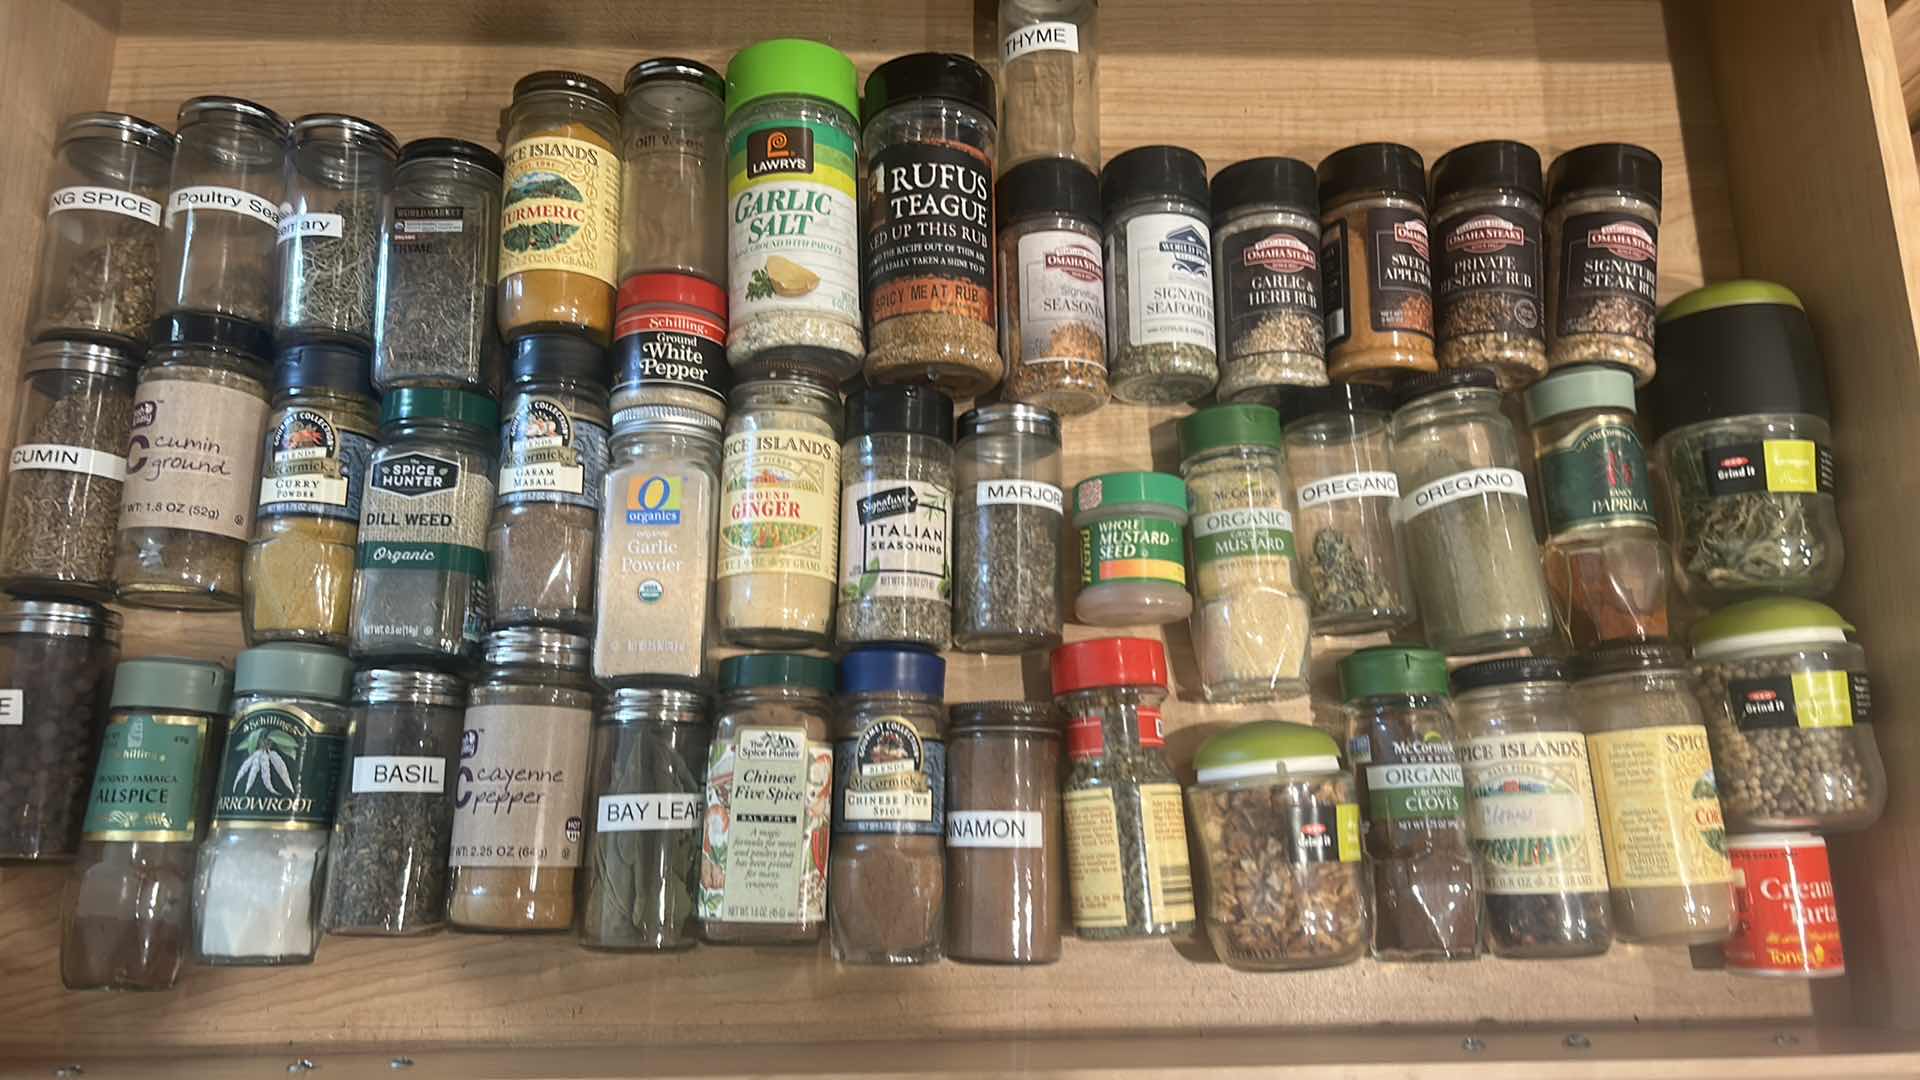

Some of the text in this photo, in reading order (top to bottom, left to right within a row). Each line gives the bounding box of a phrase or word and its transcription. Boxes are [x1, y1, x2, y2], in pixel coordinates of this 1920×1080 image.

[1005, 28, 1066, 57] THYME
[529, 143, 599, 167] ISLANDS
[891, 162, 988, 201] RUFUS
[82, 191, 153, 217] SPICE
[177, 191, 242, 214] Poultry
[735, 188, 833, 224] GARLIC
[503, 205, 586, 227] TURMERIC
[890, 194, 988, 229] TEAGUE
[748, 214, 814, 245] SALT
[891, 221, 988, 249] UP THIS RUB
[1449, 229, 1521, 245] OMAHA STEAKS
[1591, 234, 1631, 246] OMAHA
[924, 242, 943, 252] OUT
[944, 243, 955, 253] OF
[957, 245, 974, 259] THIN
[1247, 248, 1314, 261] OMAHA STEAKS
[912, 256, 939, 266] TAKEN
[969, 260, 979, 271] TO
[1047, 254, 1084, 268] OMAHA
[1391, 254, 1425, 273] SWEET
[1455, 256, 1516, 276] PRIVATE
[1251, 274, 1306, 290] GARLIC
[1506, 271, 1532, 289] RUB
[1583, 274, 1635, 291] STEAK
[910, 283, 950, 301] MEAT
[955, 283, 979, 303] RUB
[1249, 289, 1317, 309] HERB RUB
[649, 315, 705, 335] Schilling
[657, 332, 698, 347] Ground
[642, 342, 703, 364] White
[639, 359, 709, 384] Pepper
[535, 401, 568, 440] COLLECTION
[299, 411, 334, 451] COLLECTION
[154, 436, 221, 454] cumin
[756, 437, 833, 461] ISLANDS
[12, 449, 79, 465] CUMIN
[144, 456, 231, 481] ground
[390, 464, 435, 476] SPICE
[515, 467, 555, 477] GARAM
[1717, 465, 1746, 480] Grind
[275, 479, 321, 489] CURRY
[382, 475, 443, 488] HUNTER
[513, 479, 556, 488] MASALA
[1302, 477, 1397, 501] OREGANO
[1415, 472, 1515, 508] OREGANO
[276, 490, 316, 499] POWDER
[742, 490, 790, 500] GROUND
[146, 502, 162, 513] 1.8
[166, 502, 187, 513] OZ
[188, 505, 220, 520] (52g)
[731, 500, 801, 520] GINGER
[1591, 497, 1649, 514] PAPRIKA
[366, 512, 453, 528] DILL WEED
[628, 510, 678, 524] organics
[1098, 519, 1138, 532] WHOLE
[1207, 511, 1285, 531] ORGANIC
[871, 524, 943, 542] ITALIAN
[1099, 530, 1170, 546] MUSTARD
[627, 538, 678, 555] Garlic
[871, 541, 943, 555] SEASONING
[1099, 543, 1137, 560] SEED
[1215, 537, 1285, 555] MUSTARD
[372, 546, 436, 565] Organic
[621, 557, 685, 574] Powder
[1744, 700, 1775, 714] Grind
[750, 740, 763, 748] The
[858, 720, 920, 764] GOURMET COLLECTION
[742, 747, 767, 759] Spice
[1499, 740, 1584, 762] ISLANDS
[133, 775, 177, 785] JAMAICA
[374, 764, 439, 784] BASIL
[477, 767, 564, 791] cayenne
[743, 768, 797, 784] Chinese
[852, 774, 919, 791] McCormick
[1385, 768, 1461, 785] ORGANIC
[97, 788, 169, 804] ALLSPICE
[473, 791, 544, 815] pepper
[735, 785, 803, 805] Five Spice
[848, 792, 928, 806] CHINESE FIVE
[607, 801, 704, 823] BAY LEAF
[873, 806, 902, 816] SPICE
[1405, 796, 1460, 812] CLOVES
[470, 847, 493, 857] 2.25
[496, 847, 515, 857] OZ
[1759, 877, 1835, 901] Cream
